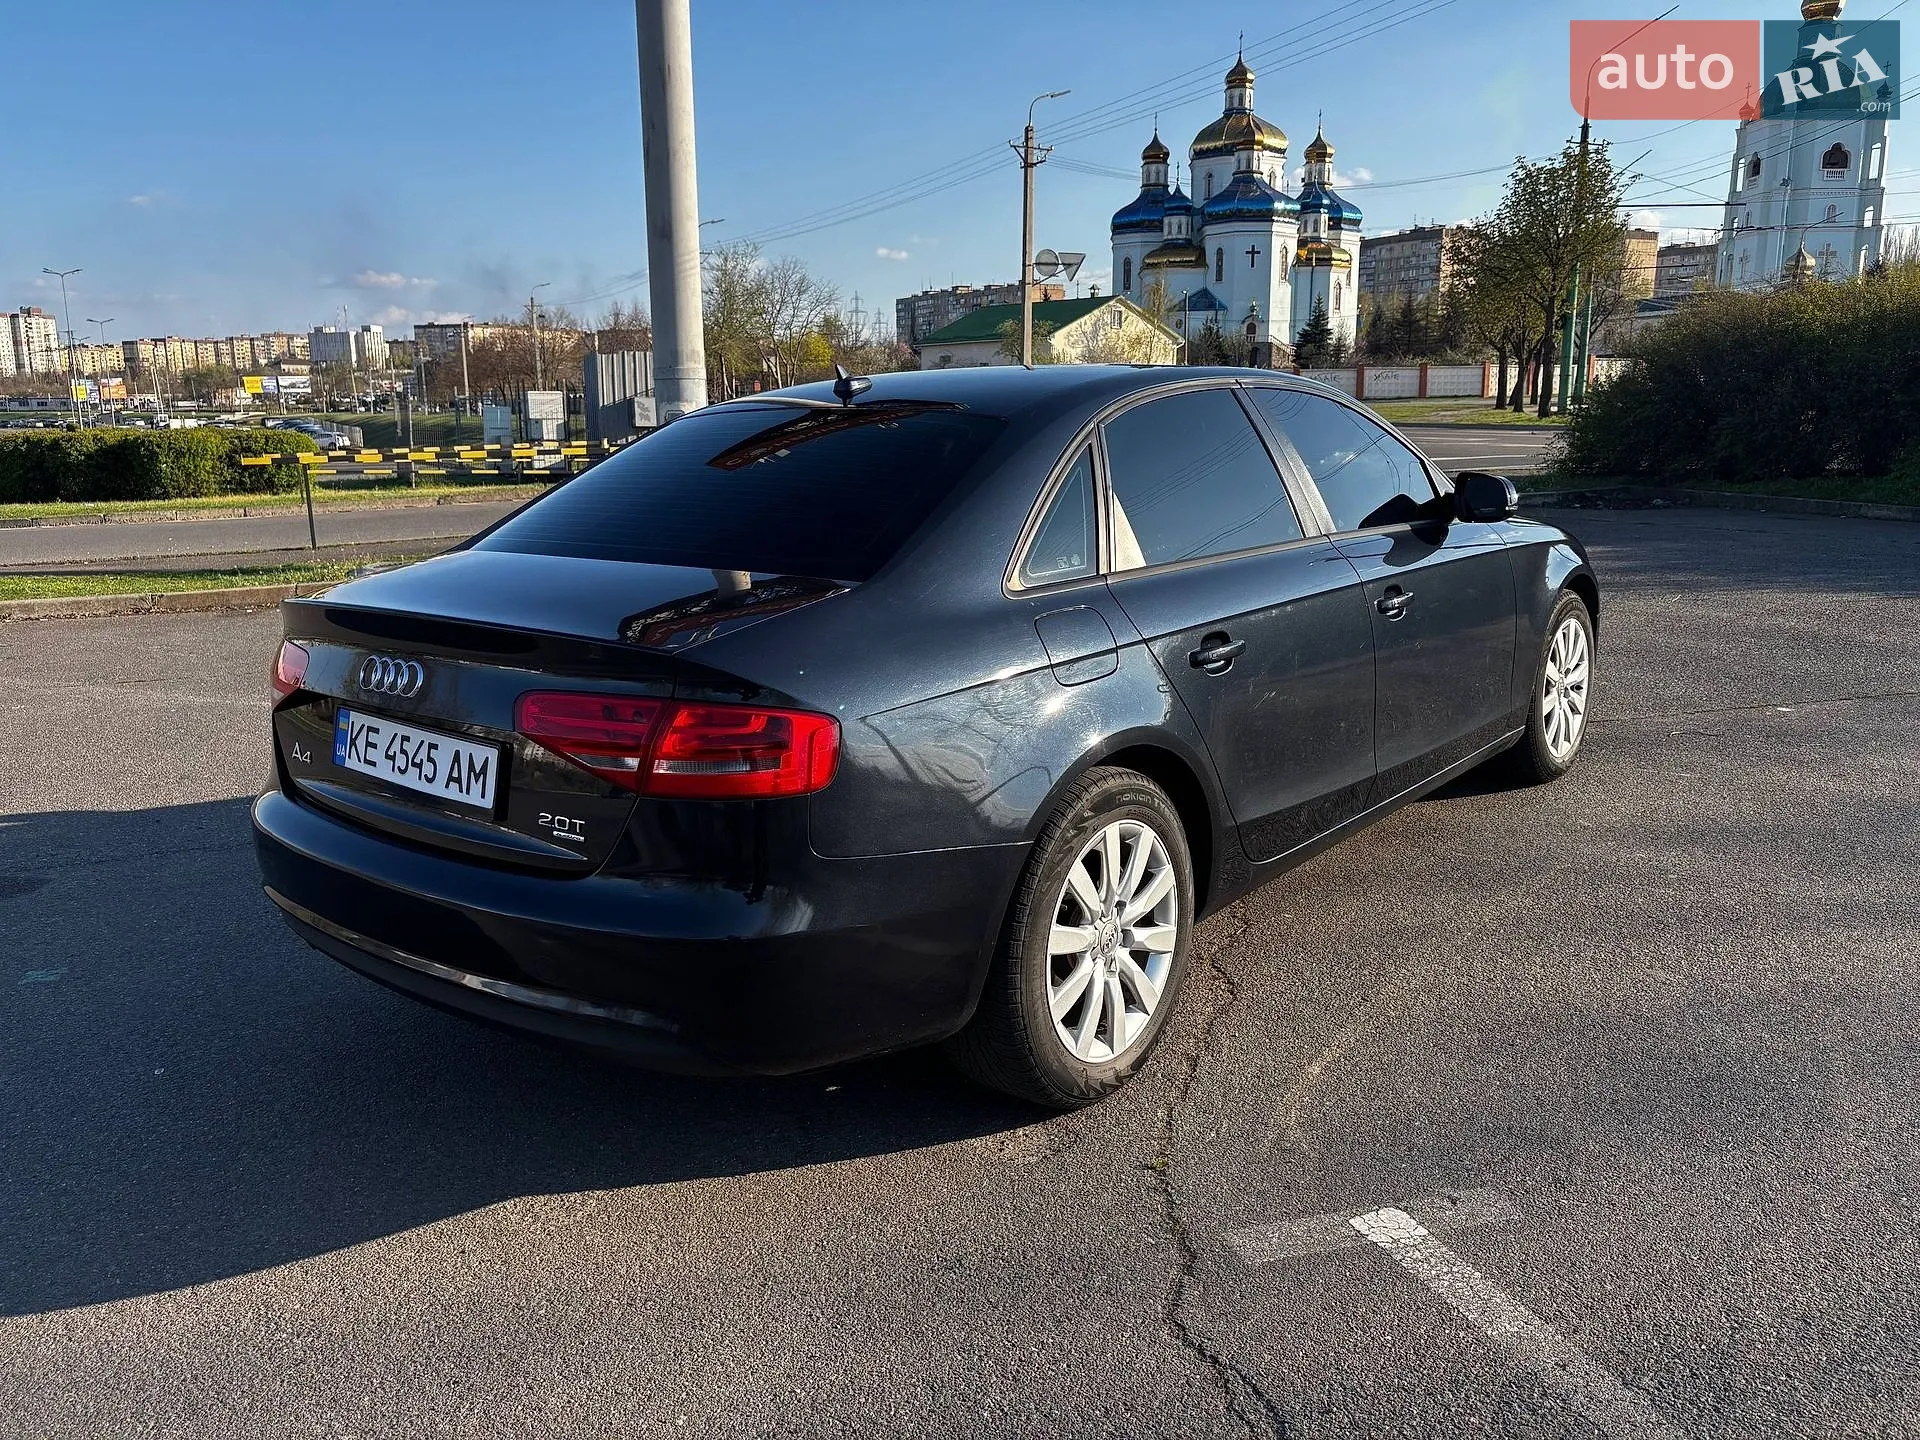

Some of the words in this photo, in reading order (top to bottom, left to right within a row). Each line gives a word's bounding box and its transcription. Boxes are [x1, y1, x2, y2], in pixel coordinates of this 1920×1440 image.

[291, 741, 311, 764] A4
[336, 743, 346, 758] UA
[347, 720, 380, 768] KE
[384, 732, 440, 784] 4545
[444, 749, 490, 800] AM
[538, 812, 586, 833] 2.0T
